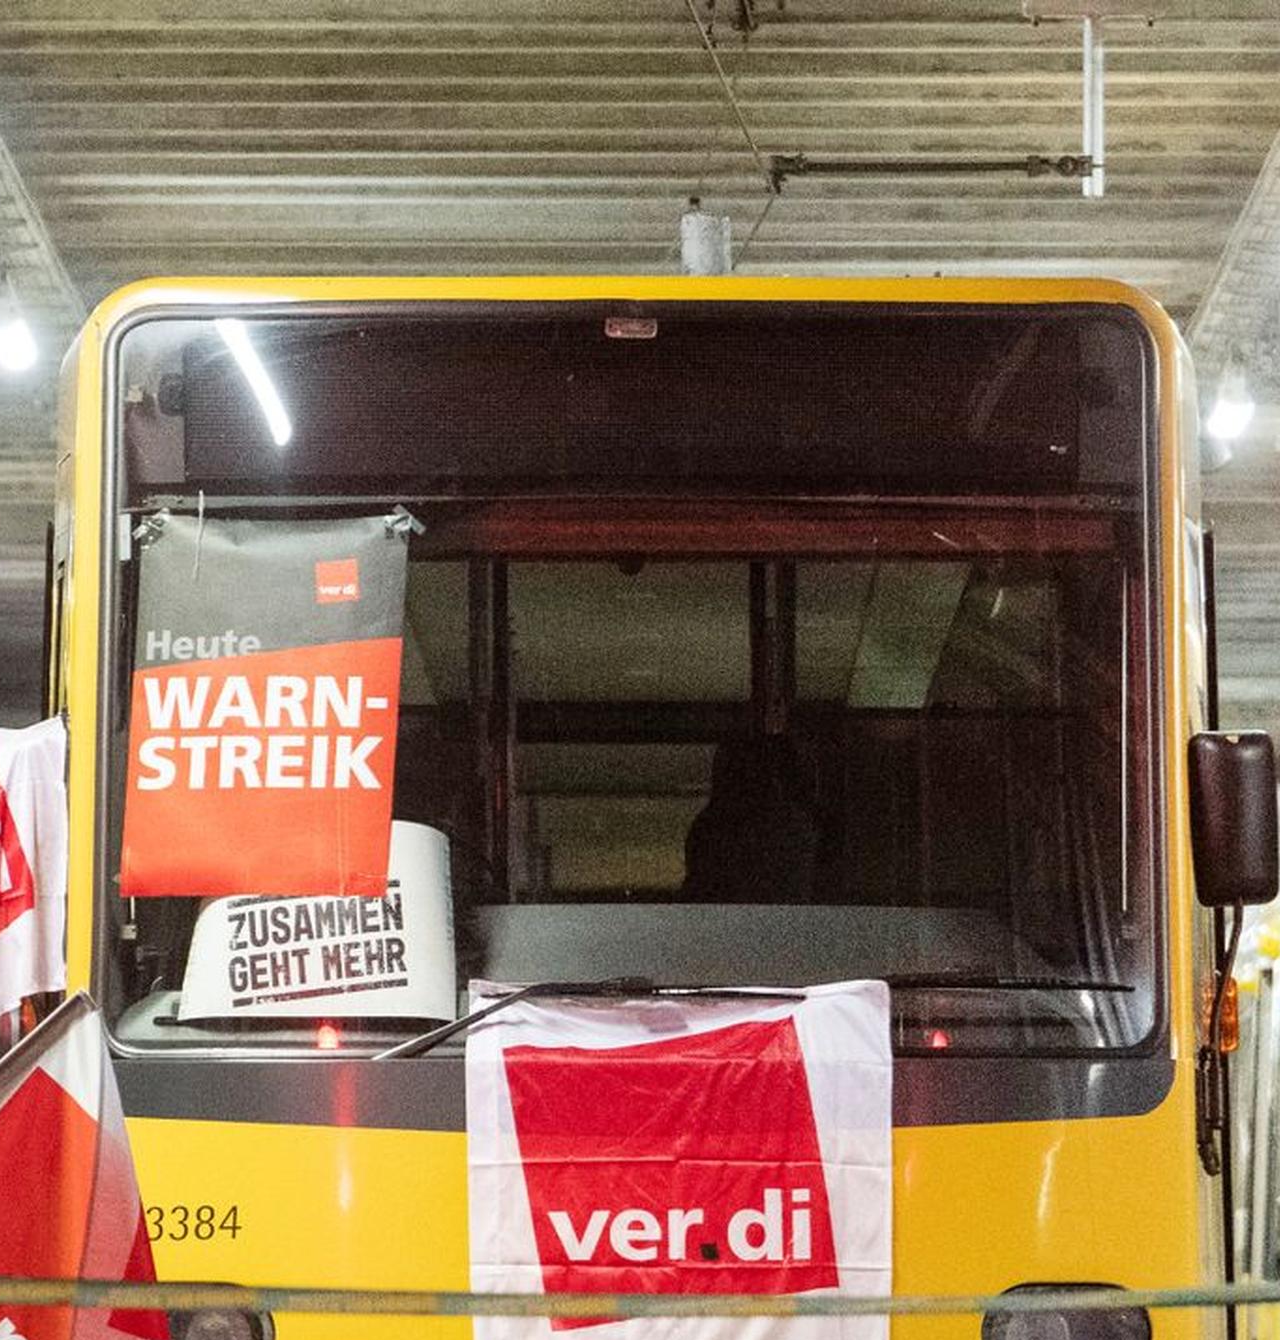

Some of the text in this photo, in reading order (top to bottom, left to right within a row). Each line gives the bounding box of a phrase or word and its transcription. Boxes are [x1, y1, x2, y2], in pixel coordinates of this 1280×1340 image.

[145, 629, 262, 661] Heute
[143, 675, 389, 730] WARN-
[136, 735, 383, 790] STREIK
[228, 893, 405, 951] ZUSAMMEN
[229, 937, 407, 993] GEHT MEHR
[146, 1204, 242, 1241] 3384
